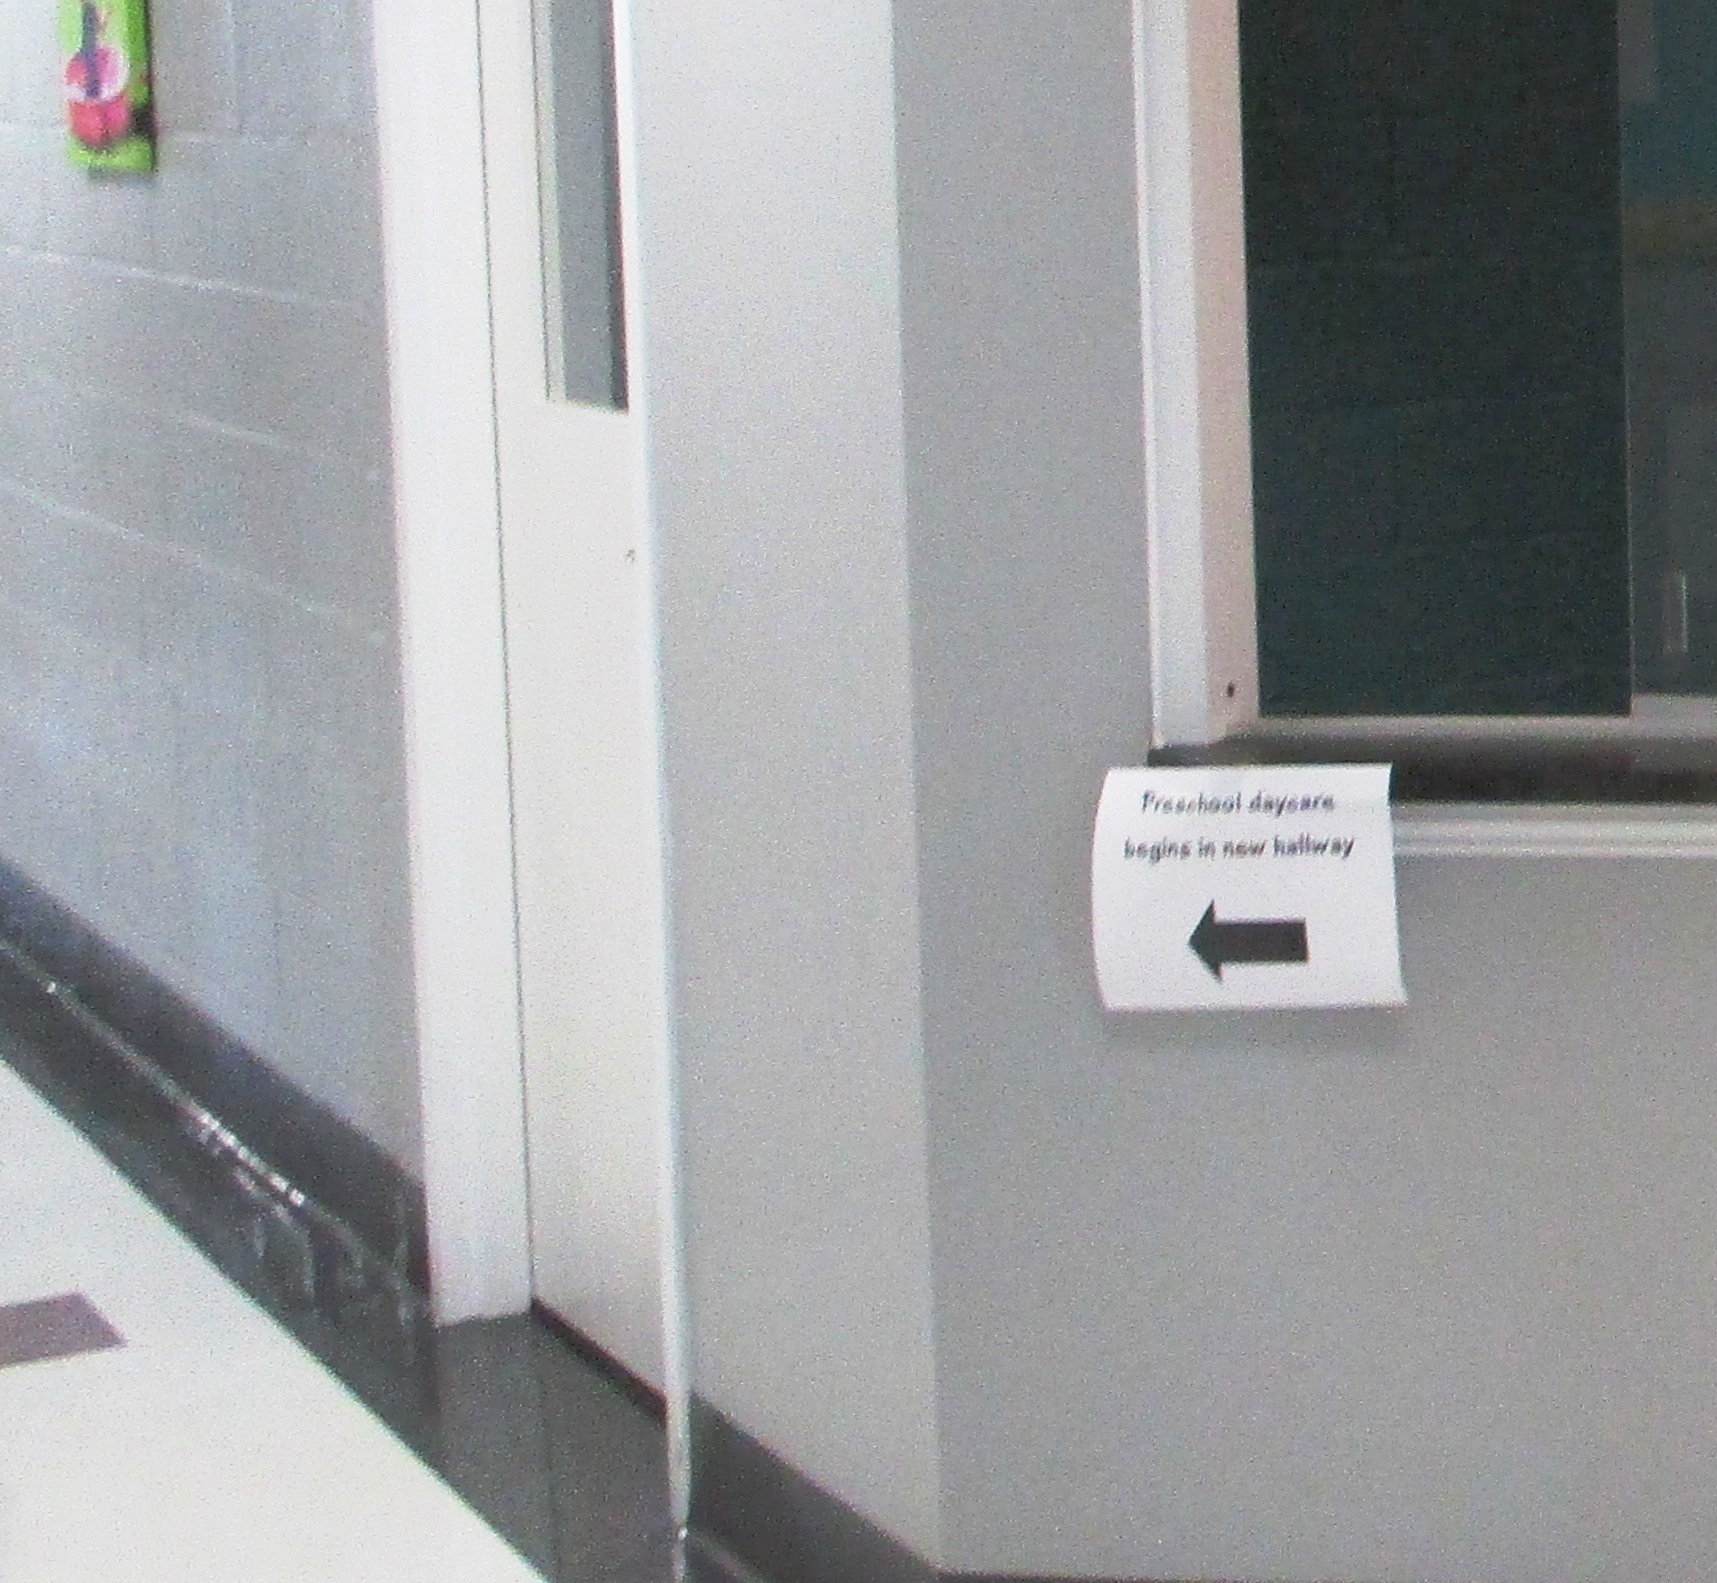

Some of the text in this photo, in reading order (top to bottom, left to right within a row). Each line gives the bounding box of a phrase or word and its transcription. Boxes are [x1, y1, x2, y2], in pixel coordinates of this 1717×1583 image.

[1141, 789, 1335, 818] Preschool daycare
[1124, 832, 1355, 864] begins in new hallway
